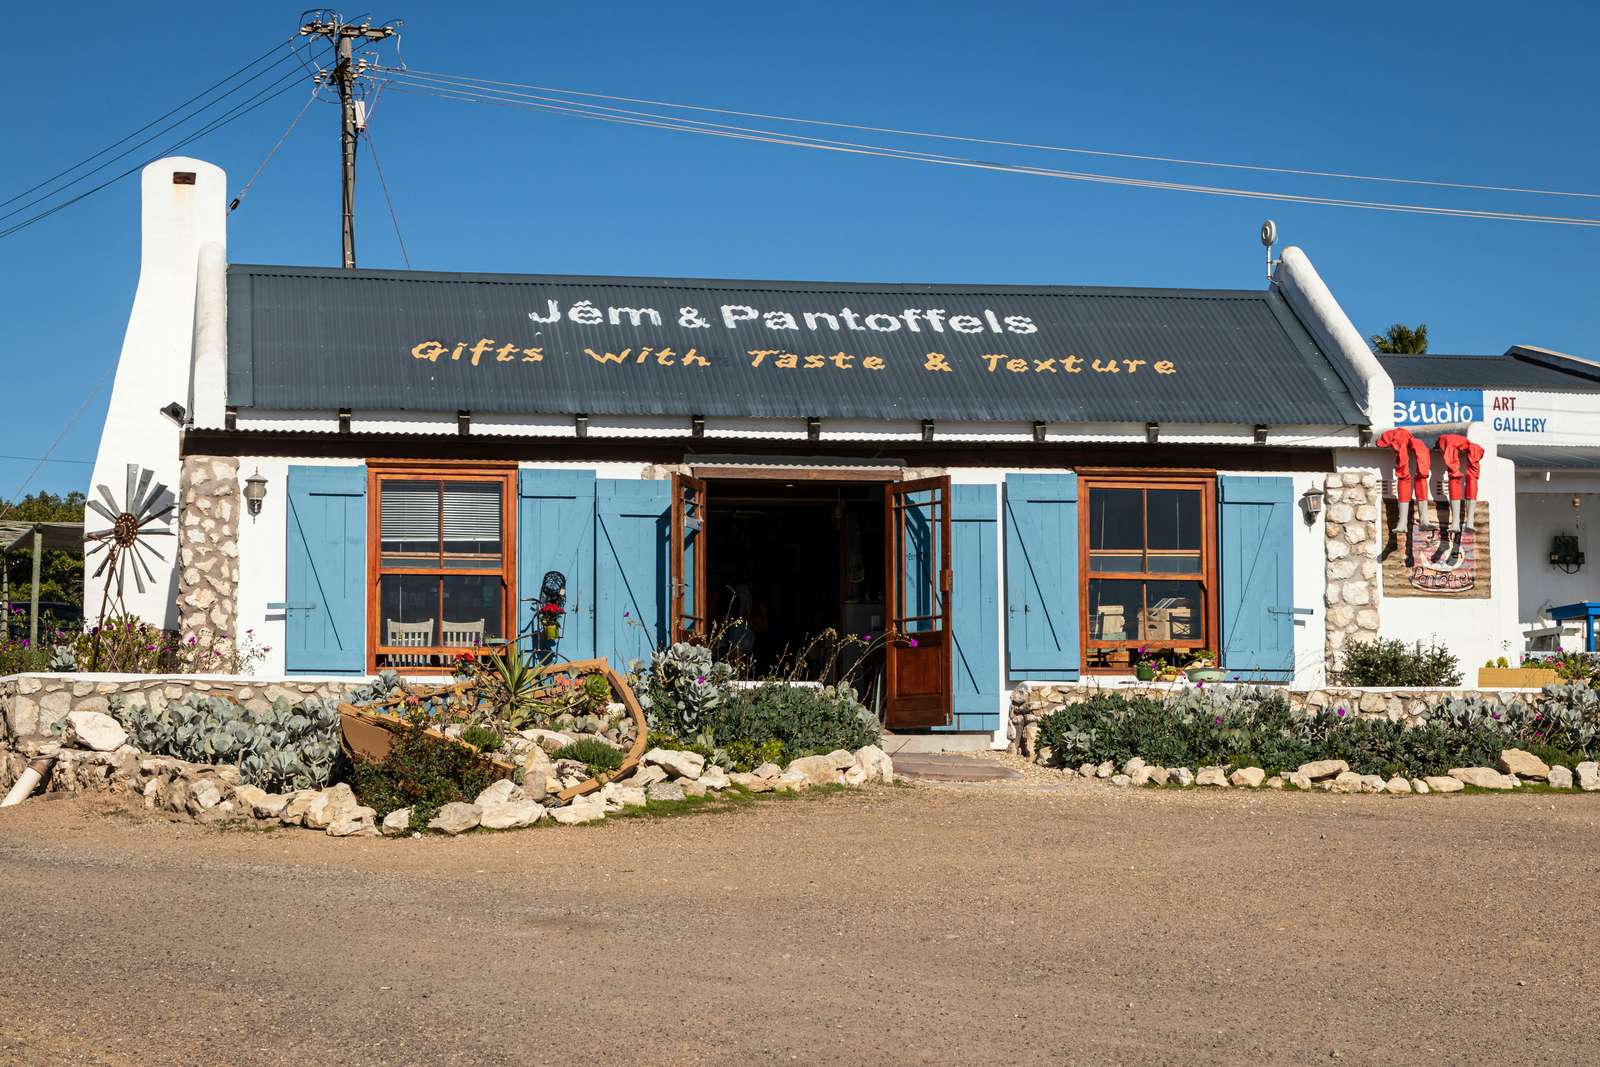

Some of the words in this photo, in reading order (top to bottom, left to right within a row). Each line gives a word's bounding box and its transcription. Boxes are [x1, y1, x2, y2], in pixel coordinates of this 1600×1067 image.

[679, 306, 711, 329] &
[720, 304, 1038, 335] Pantoffels
[411, 338, 544, 366] Gifts
[749, 350, 886, 371] Taste
[924, 352, 952, 372] &
[983, 353, 1177, 375] Texture
[1493, 396, 1517, 411] ART
[1493, 417, 1547, 432] GALLERY
